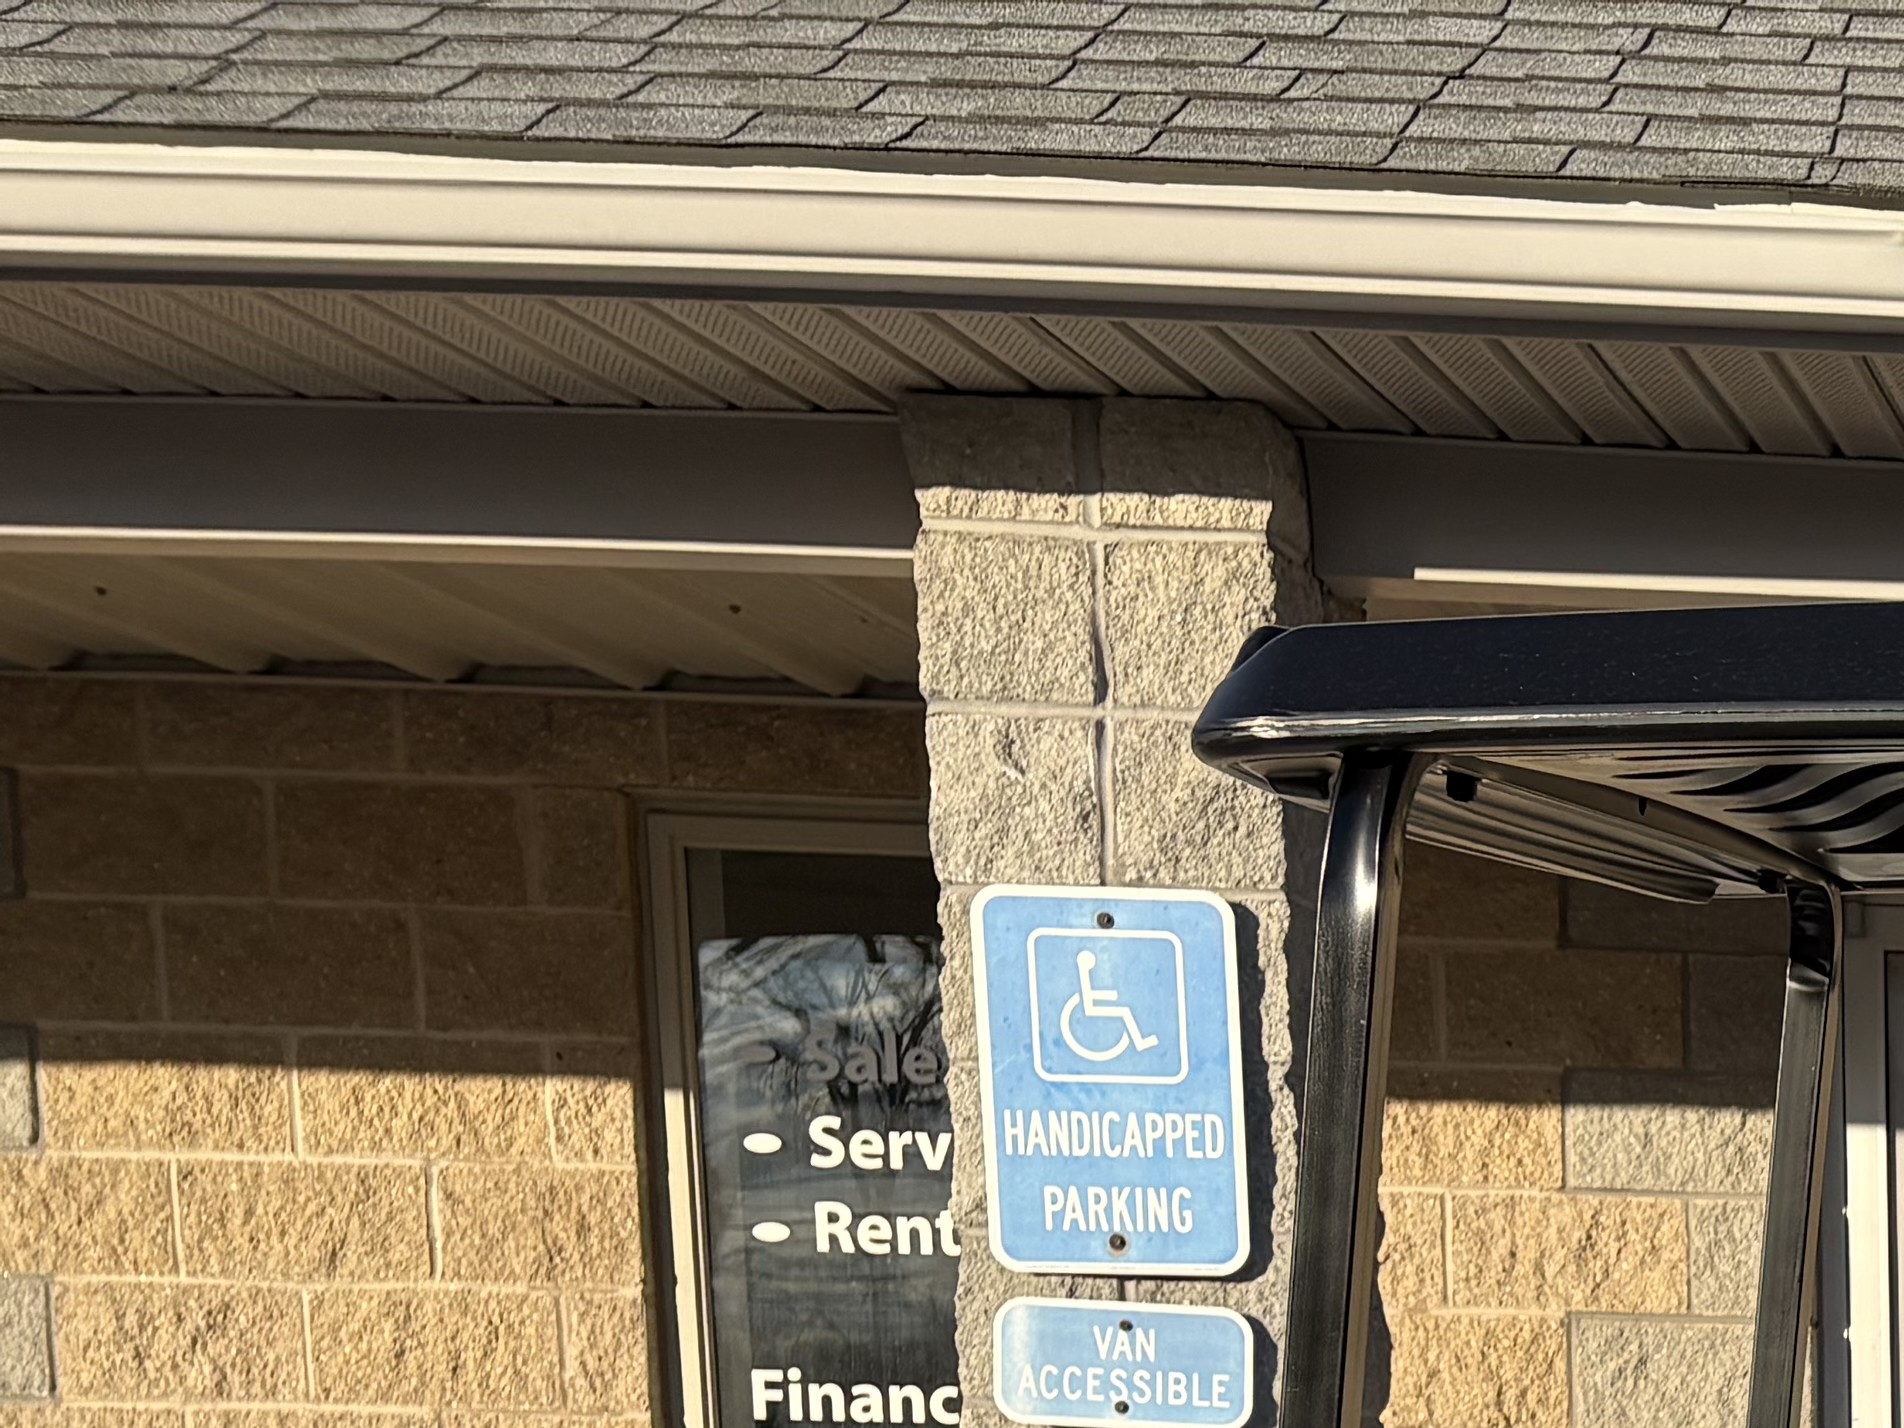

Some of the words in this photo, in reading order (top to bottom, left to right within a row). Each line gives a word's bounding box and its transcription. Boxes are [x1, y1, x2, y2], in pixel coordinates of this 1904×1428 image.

[808, 1114, 952, 1171] Serv
[1003, 1110, 1226, 1161] HANDICAPPED
[814, 1200, 961, 1257] Rent
[1043, 1184, 1195, 1236] PARKING
[1093, 1325, 1157, 1364] VAN
[751, 1367, 961, 1425] Financ
[1017, 1364, 1232, 1411] ACCESSIBLE
